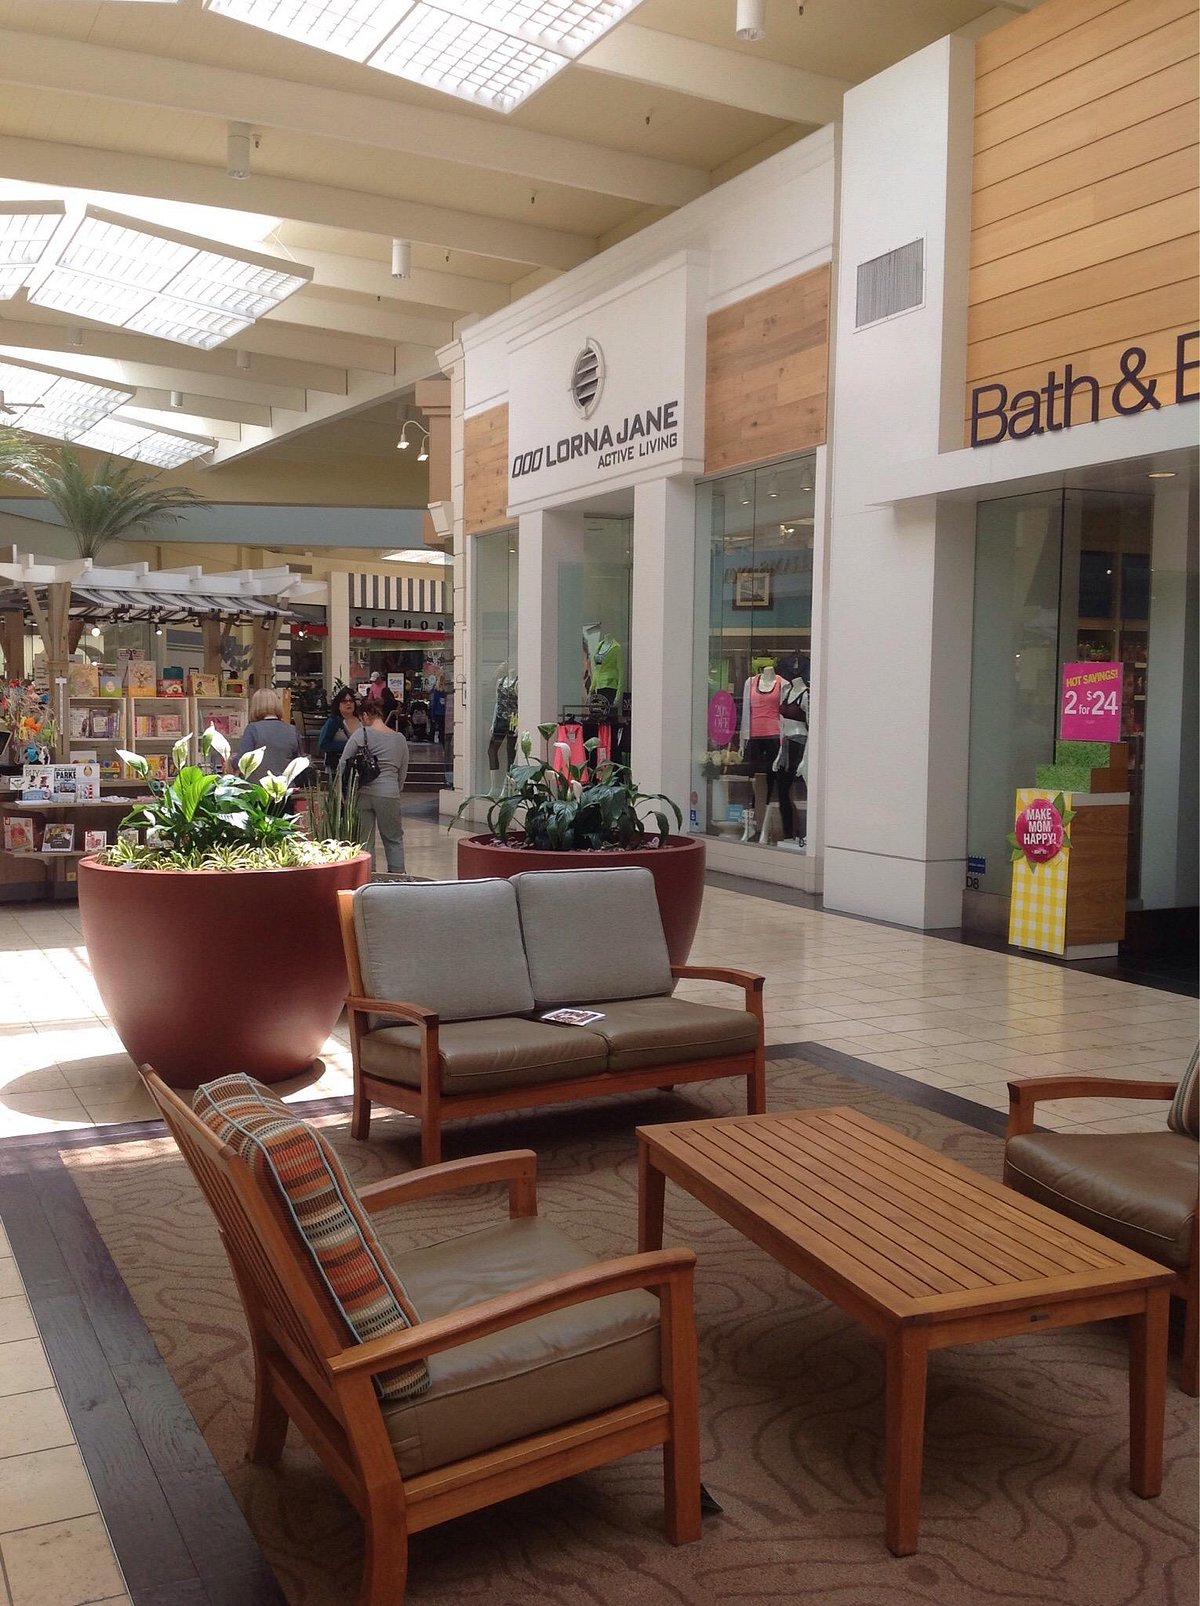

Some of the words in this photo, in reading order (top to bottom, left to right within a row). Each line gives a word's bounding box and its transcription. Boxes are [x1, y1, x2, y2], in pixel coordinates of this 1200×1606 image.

[971, 364, 1099, 447] Bath
[1111, 347, 1162, 415] &
[546, 425, 613, 467] LORNA
[617, 401, 678, 444] JANE
[598, 446, 634, 469] ACTIVE
[639, 432, 678, 457] LIVING
[1066, 676, 1082, 687] HOT
[1083, 669, 1118, 684] SAVINGS!
[1064, 690, 1078, 714] 2
[1079, 704, 1090, 715] for
[1027, 808, 1052, 820] MAKE
[1028, 820, 1051, 832] MOM
[1023, 833, 1057, 845] HAPPY!
[966, 876, 979, 889] D8
